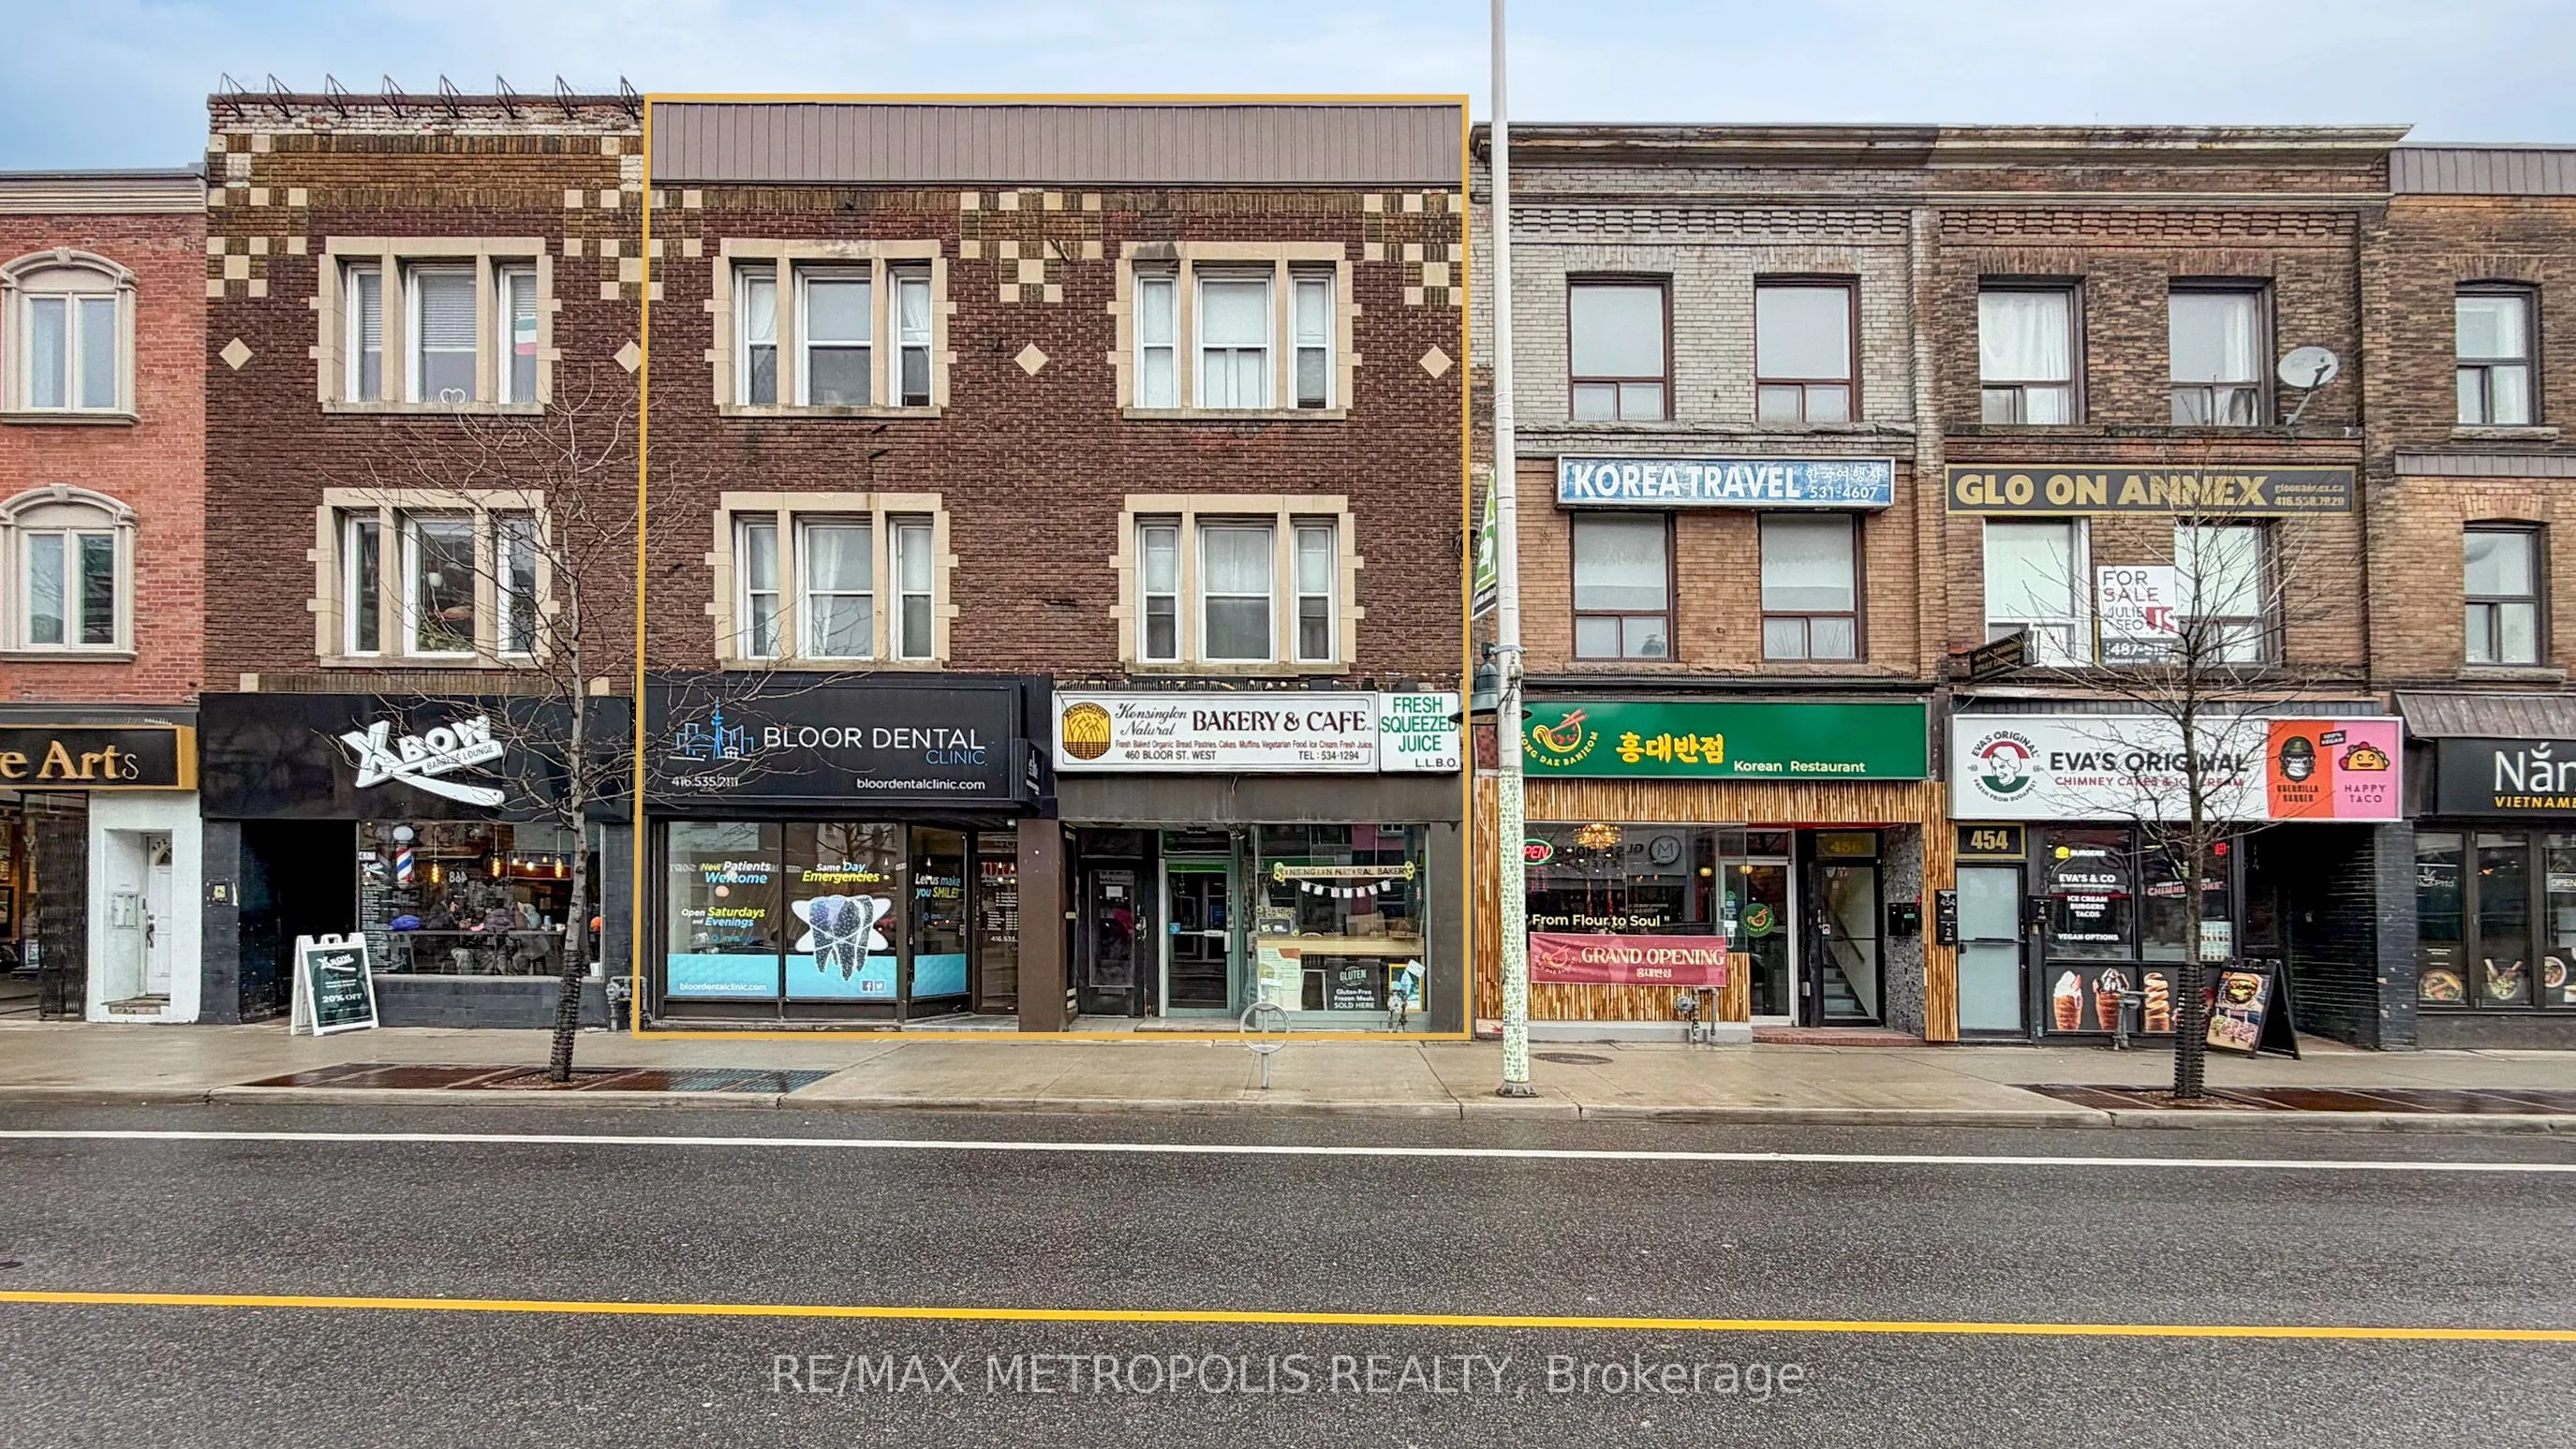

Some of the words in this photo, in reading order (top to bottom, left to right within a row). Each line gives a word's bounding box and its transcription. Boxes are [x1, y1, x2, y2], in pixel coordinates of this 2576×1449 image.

[1574, 466, 1680, 496] KOREA
[1687, 466, 1800, 497] TRAVEL
[1810, 486, 1878, 499] 531-4607
[1956, 474, 2035, 506] GLO
[2045, 474, 2108, 506] ON
[2117, 475, 2268, 506] ANNEX
[2103, 570, 2148, 585] FOR
[2104, 587, 2158, 602] SALE
[2107, 606, 2143, 618] JULIE
[2116, 619, 2144, 630] SEO
[1393, 696, 1443, 713] FRESH
[1115, 702, 1187, 725] Kensington
[1119, 720, 1177, 736] Natural
[1192, 710, 1281, 732] BAKERY
[1283, 711, 1300, 732] &
[1307, 710, 1367, 734] CAFE
[1381, 716, 1458, 733] SQUEEZED
[763, 727, 863, 748] BLOOR
[872, 728, 985, 749] DENTAL
[1116, 739, 1131, 749] Fresh
[1133, 739, 1150, 749] Baked
[1152, 739, 1174, 749] Organic
[1262, 739, 1291, 749] Vegetarian
[1340, 739, 1355, 749] Fresh
[1399, 735, 1443, 752] JUICE
[1993, 731, 2036, 757] ORIGINAL
[464, 745, 495, 761] LOUNGE
[1616, 732, 1725, 764] 홍대반점
[0, 750, 29, 779] e
[37, 739, 140, 780] Arts
[925, 749, 985, 765] CLINIC
[1125, 751, 1140, 760] 460
[1143, 751, 1173, 760] BLOOR
[1176, 751, 1190, 760] ST.
[1192, 751, 1216, 760] WEST
[1322, 751, 1359, 760] 534-1294
[2124, 752, 2248, 772] ORIGNAL
[1415, 758, 1458, 767] L.L.B.O.
[1734, 761, 1783, 772] Korean
[1790, 761, 1866, 773] Restaurant
[856, 778, 986, 791] bloordentalclinic.com
[2054, 776, 2114, 786] CHIMNEY
[2118, 776, 2158, 786] CAKES
[2345, 784, 2387, 792] HAPPY
[1990, 793, 2008, 803] FROM
[2349, 794, 2383, 803] TACO
[1970, 830, 2009, 850] 454
[1523, 844, 1550, 860] PEN
[699, 863, 721, 872] New
[722, 861, 771, 872] Patients
[816, 863, 841, 872] Same
[842, 862, 866, 873] Day
[705, 871, 768, 884] Welcome
[802, 870, 881, 884] Emergencies
[940, 875, 961, 886] make
[2089, 874, 2098, 882] &
[2100, 874, 2116, 882] CO
[2147, 884, 2186, 896] CHIMNE
[681, 908, 706, 917] Open
[707, 907, 765, 919] Saturdays
[704, 917, 754, 928] Evenings
[1532, 914, 1569, 925] From
[1573, 914, 1608, 926] Flour
[1612, 916, 1627, 926] to
[1630, 915, 1661, 926] Soul
[2084, 933, 2119, 941] OPTIONS
[1581, 947, 1642, 964] GRAND
[1646, 948, 1725, 966] OPENING
[1340, 968, 1367, 981] GLUTEN
[679, 982, 767, 992] bloordentalclinic.com
[322, 995, 345, 1003] 20%
[346, 993, 363, 1001] OFF
